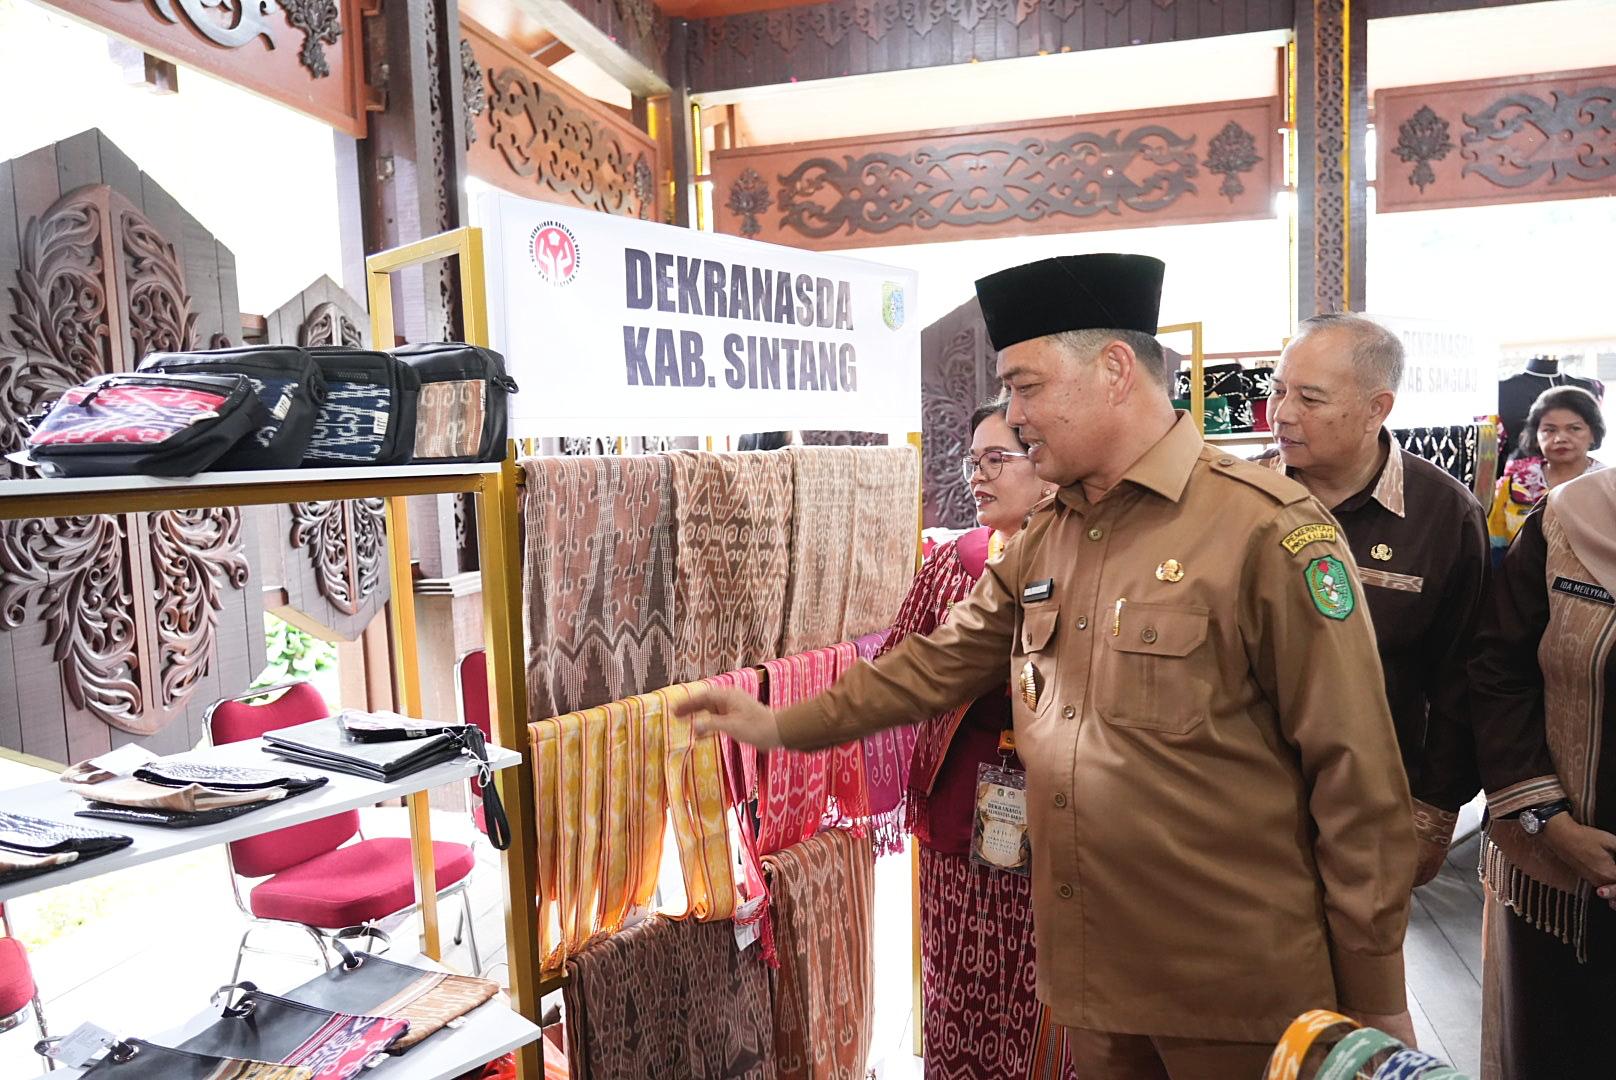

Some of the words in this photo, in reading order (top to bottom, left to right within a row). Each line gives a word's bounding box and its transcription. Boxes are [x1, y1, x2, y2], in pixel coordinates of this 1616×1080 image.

[624, 248, 855, 331] DEKRANASDA
[623, 325, 716, 388] KAB.
[723, 333, 858, 393] SINTANG
[1559, 580, 1572, 591] IDA
